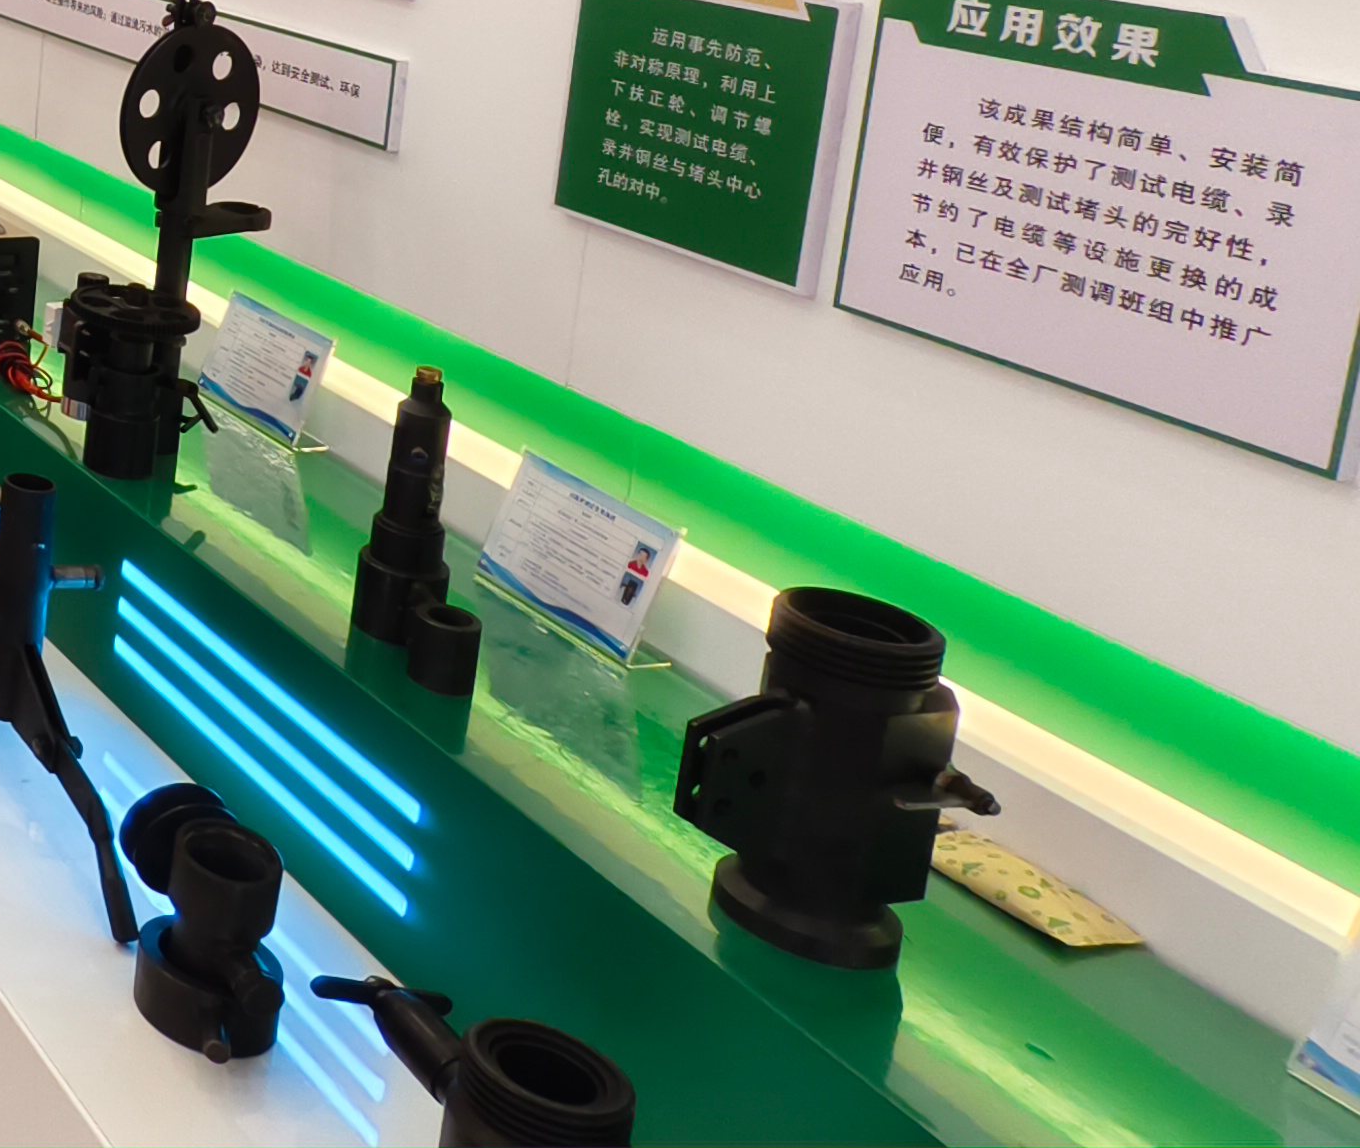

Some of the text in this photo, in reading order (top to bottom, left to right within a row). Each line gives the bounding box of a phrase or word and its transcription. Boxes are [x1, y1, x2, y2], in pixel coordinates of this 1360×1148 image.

[613, 49, 777, 104] 非对称原理，利用上
[651, 27, 773, 70] 运用事先防范、
[604, 107, 757, 167] 栓，实现测试电缆、
[610, 79, 773, 136] 下扶正轮、调节螺
[601, 137, 763, 200] 录井钢丝与堵头中心
[977, 98, 1306, 188] 该成果结构简单、安装简
[596, 167, 669, 204] 孔的对中。
[921, 122, 1296, 228] 便，有效保护了测试电缆、录
[916, 157, 1269, 267] 井钢丝及测试堵头的完好性，
[898, 262, 958, 298] 应用。
[911, 192, 1280, 313] 节约了电缆等设施更换的成
[904, 227, 1273, 347] 本，已在全厂测调班组中推广
